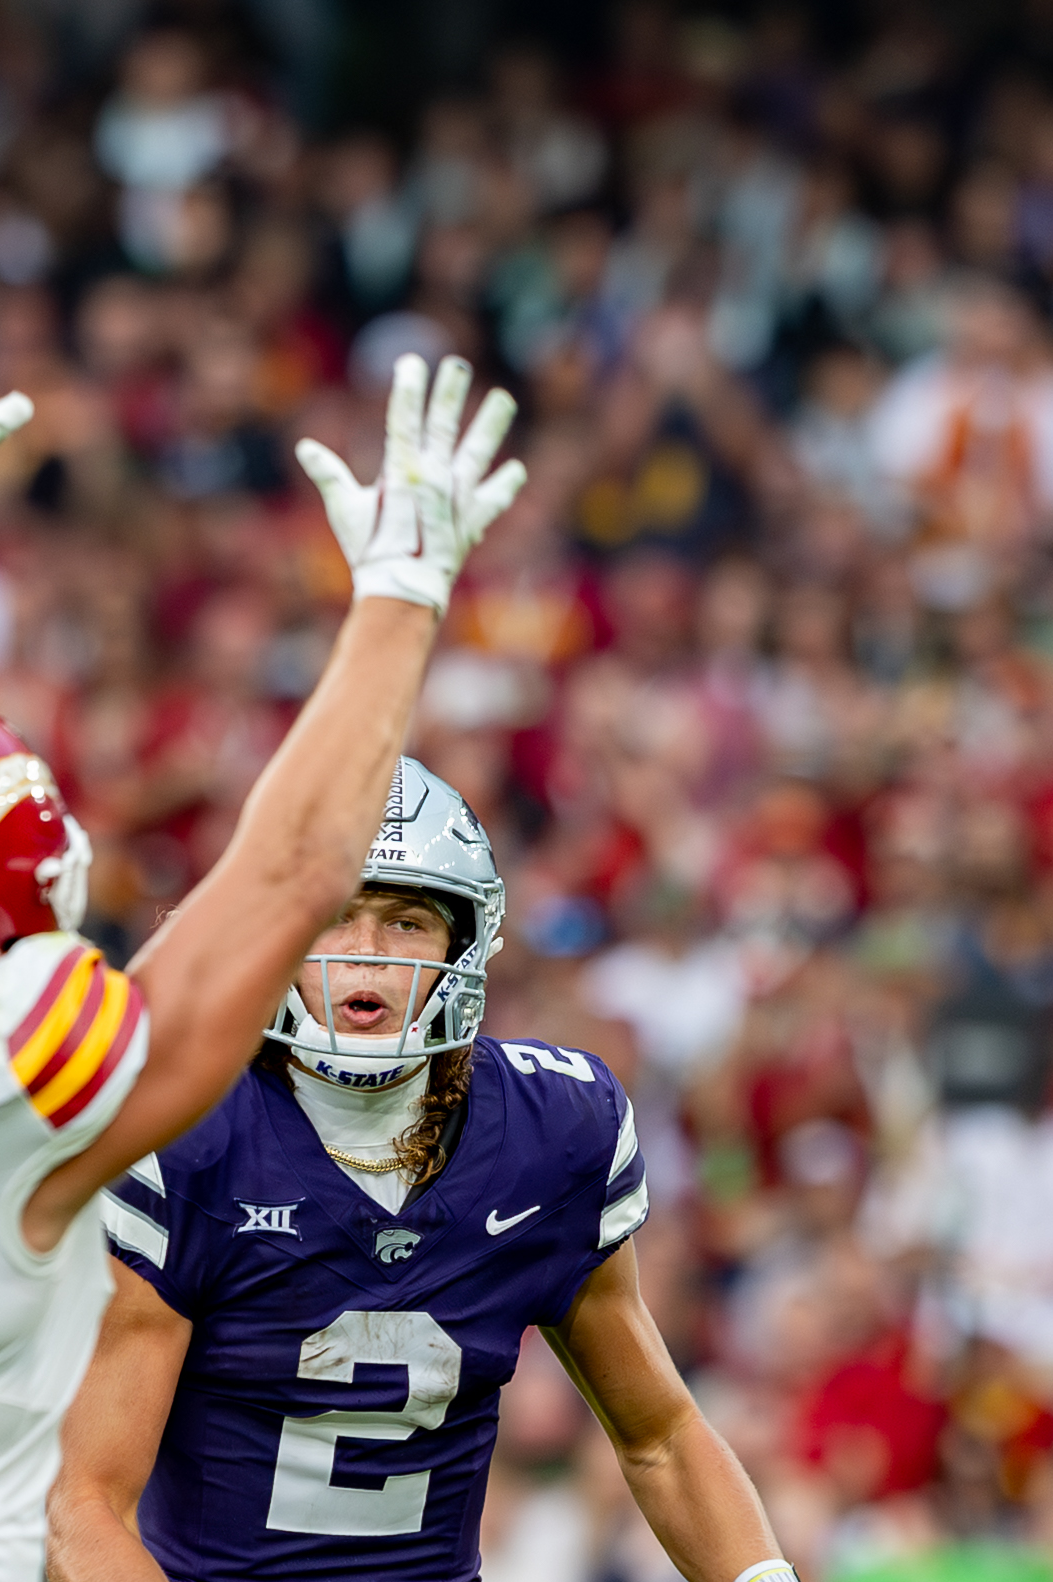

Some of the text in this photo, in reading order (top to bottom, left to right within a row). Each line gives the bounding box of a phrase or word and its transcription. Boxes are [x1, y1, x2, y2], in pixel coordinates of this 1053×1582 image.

[315, 1060, 406, 1088] K-STATE
[500, 1042, 596, 1083] 2
[237, 1203, 298, 1236] XII
[266, 1310, 462, 1537] 2
